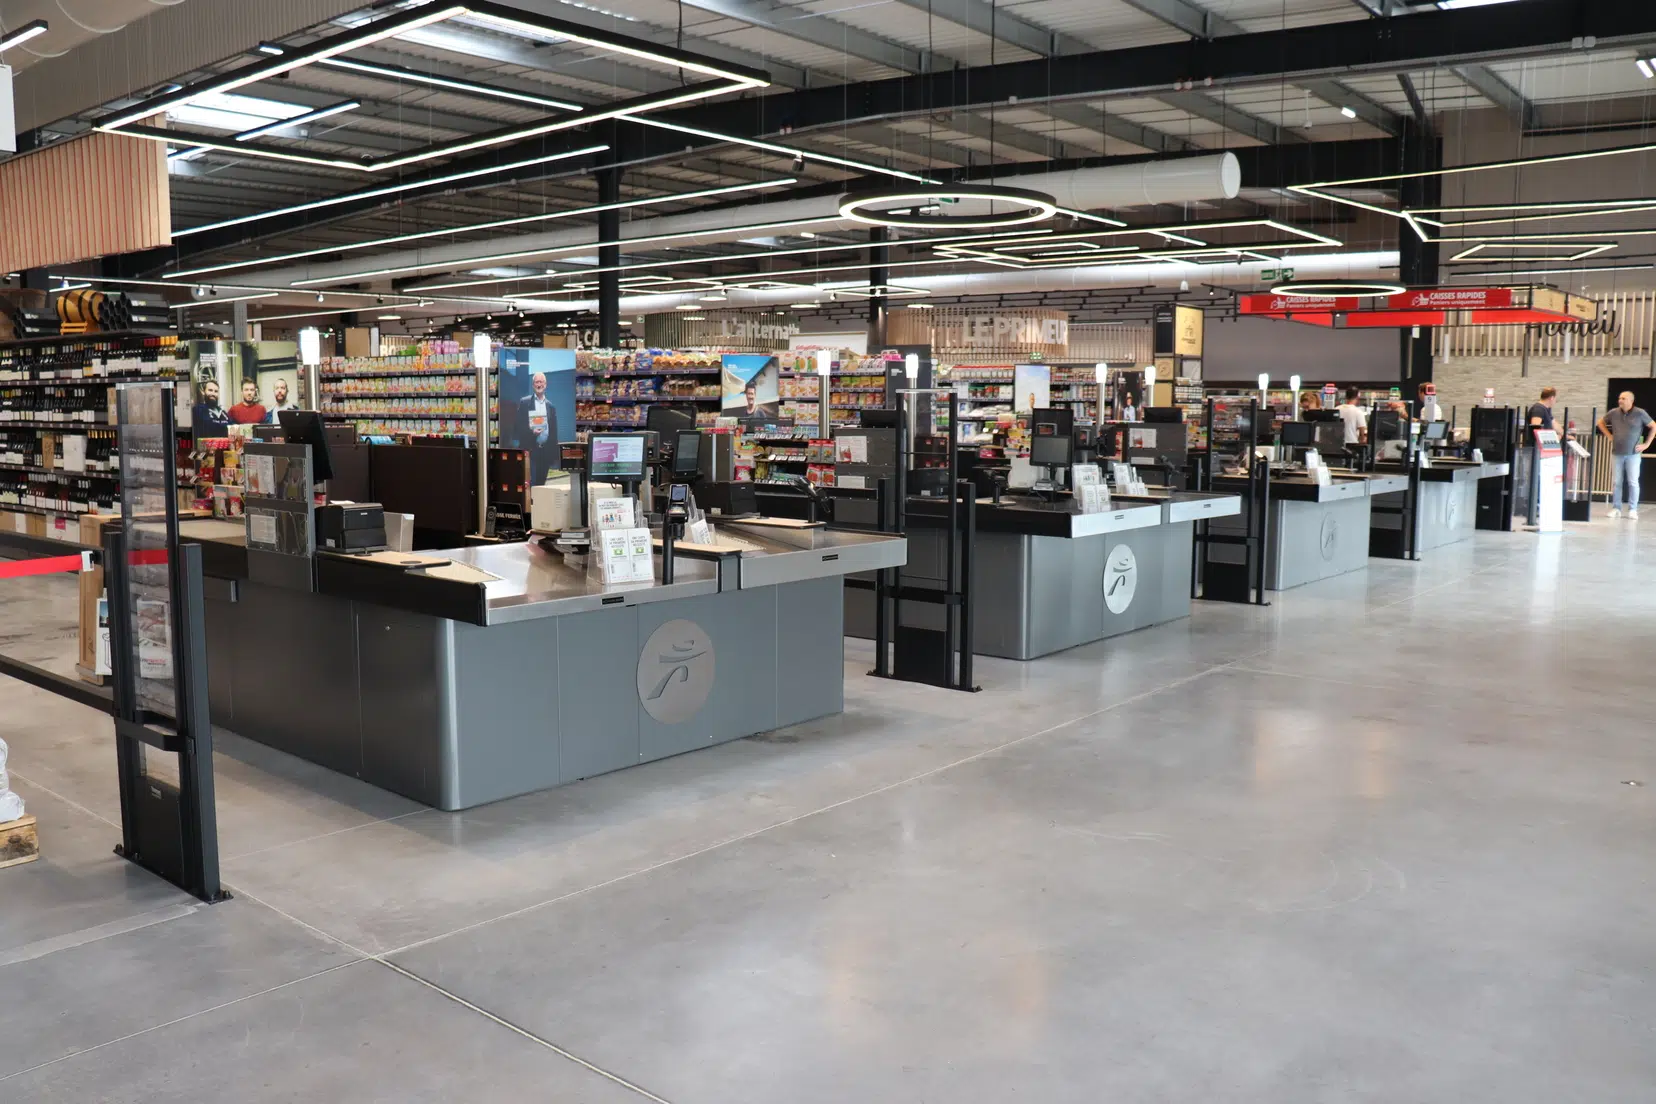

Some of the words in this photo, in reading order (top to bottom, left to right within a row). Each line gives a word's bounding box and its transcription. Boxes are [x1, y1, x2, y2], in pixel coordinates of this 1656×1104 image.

[1430, 292, 1455, 300] CAISSES
[1457, 291, 1486, 299] RAPIDES
[963, 316, 993, 342] LE
[994, 316, 1068, 345] PRIMEUR
